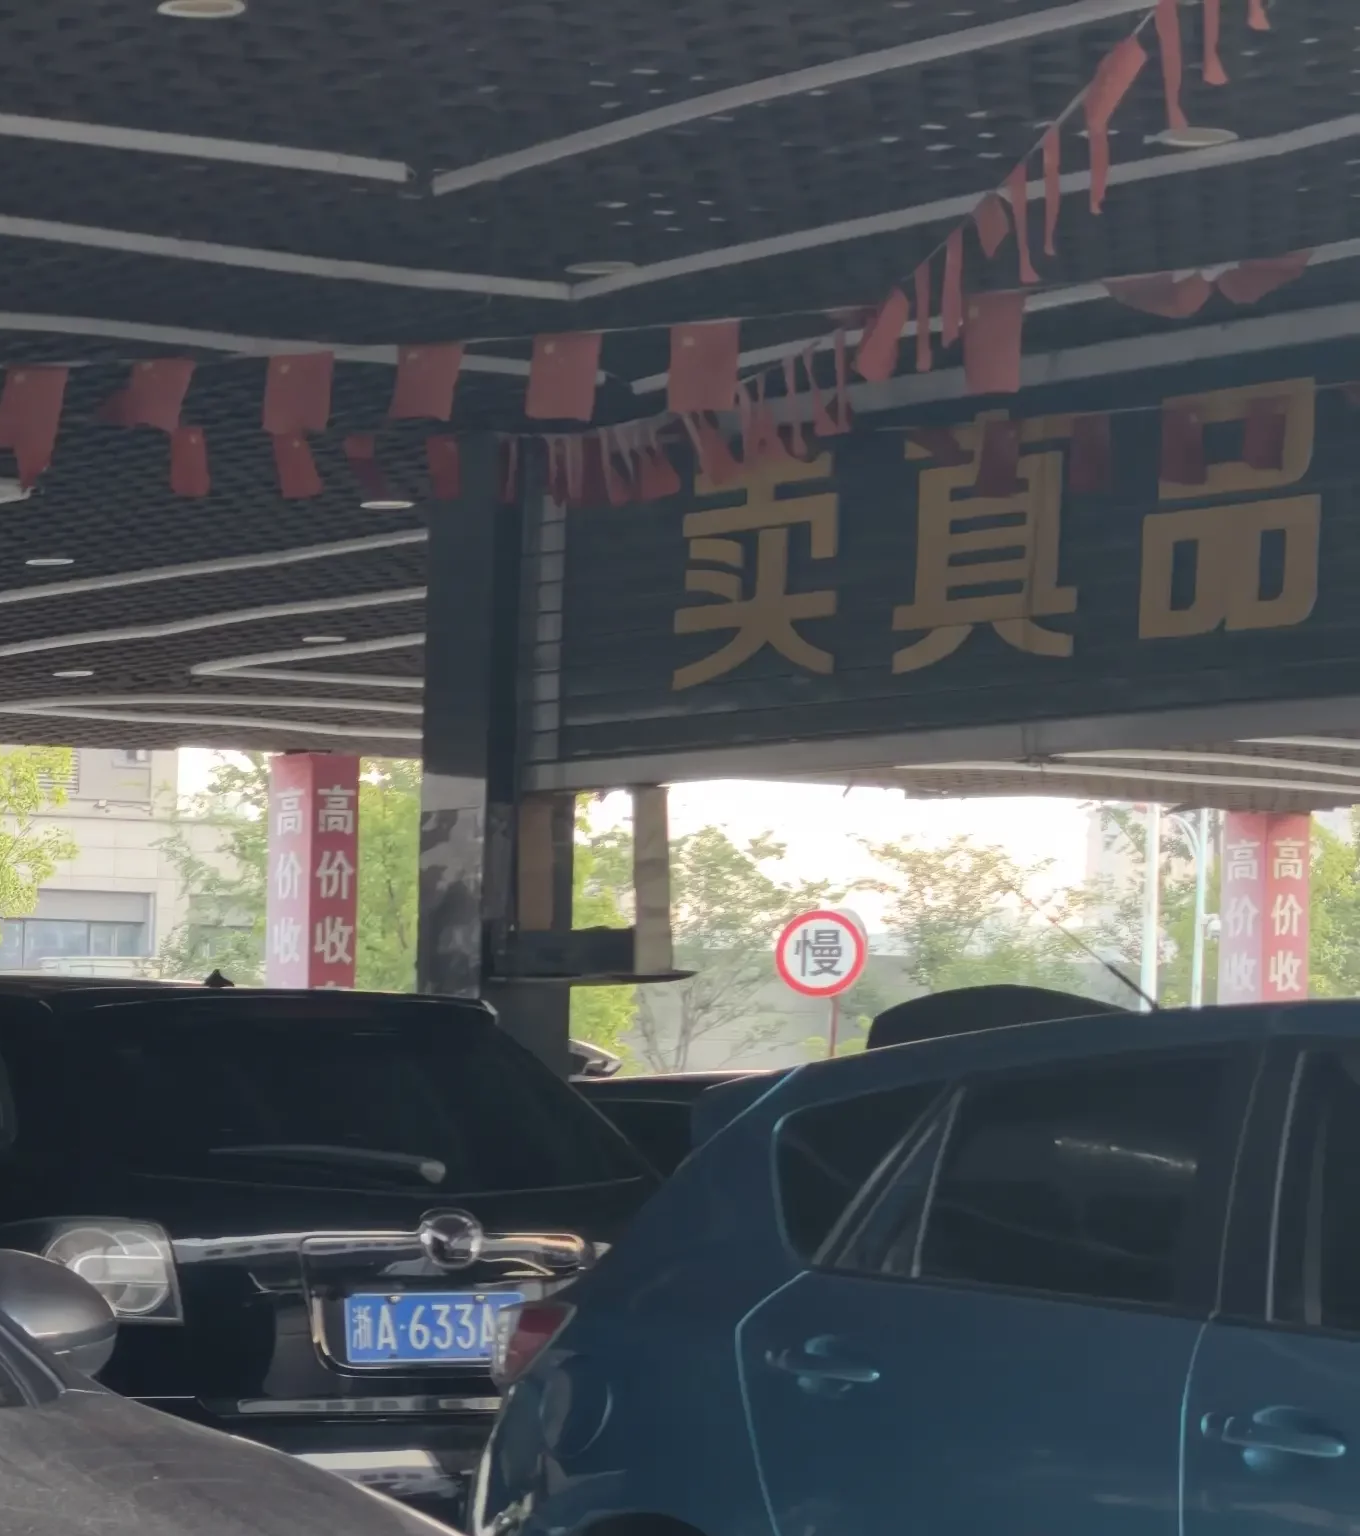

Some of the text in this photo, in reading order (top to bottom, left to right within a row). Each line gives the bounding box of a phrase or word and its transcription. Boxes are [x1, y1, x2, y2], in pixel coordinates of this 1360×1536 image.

[671, 376, 1322, 691] 卖真品
[272, 787, 306, 964] 高价收
[314, 784, 357, 989] 高价收
[794, 928, 844, 977] 慢
[1225, 839, 1261, 992] 高价收
[1268, 837, 1307, 992] 高价收
[352, 1304, 510, 1352] 浙A·633A
